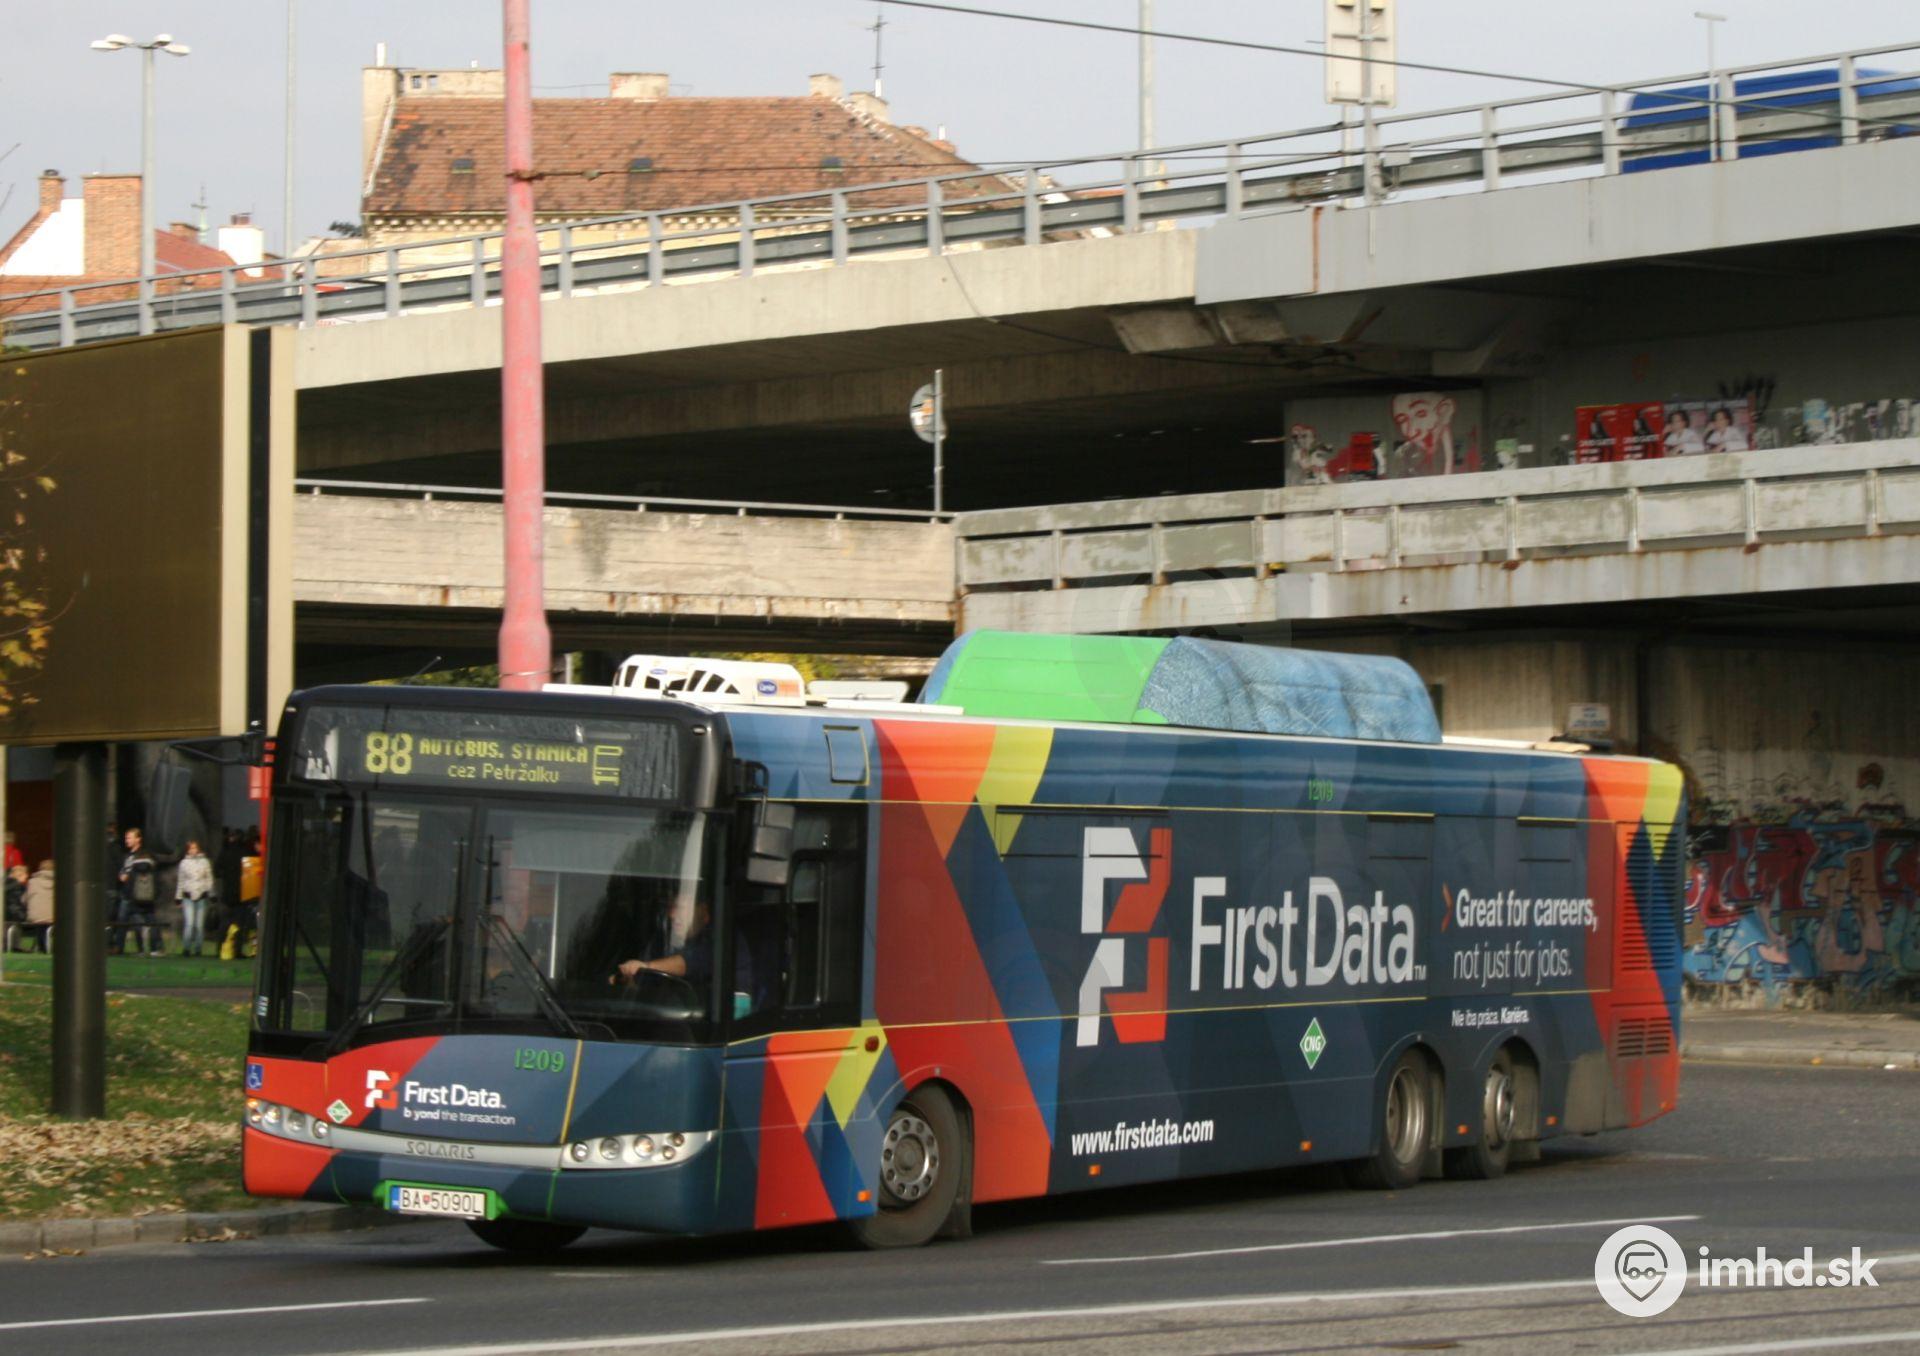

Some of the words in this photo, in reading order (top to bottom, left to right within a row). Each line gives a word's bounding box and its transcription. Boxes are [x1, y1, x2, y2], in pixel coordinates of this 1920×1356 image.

[365, 731, 413, 775] 88
[447, 764, 476, 779] cez
[483, 762, 560, 783] Petržalku
[1308, 779, 1334, 802] 1209
[1456, 888, 1503, 928] Great
[1507, 889, 1530, 928] for
[1533, 898, 1599, 932] careers,
[1190, 876, 1298, 991] First
[1305, 876, 1415, 986] Data
[1453, 943, 1479, 980] not
[1481, 941, 1511, 988] just
[1514, 940, 1535, 978] for
[1535, 940, 1573, 986] jobs.
[1303, 1035, 1322, 1053] CNG
[514, 1048, 566, 1073] 1209
[404, 1080, 448, 1106] First
[450, 1083, 502, 1109] Data
[441, 1109, 458, 1122] the
[459, 1111, 516, 1126] transaction
[405, 1140, 476, 1160] SOLARIS
[1071, 1118, 1215, 1156] www.firstdata.com
